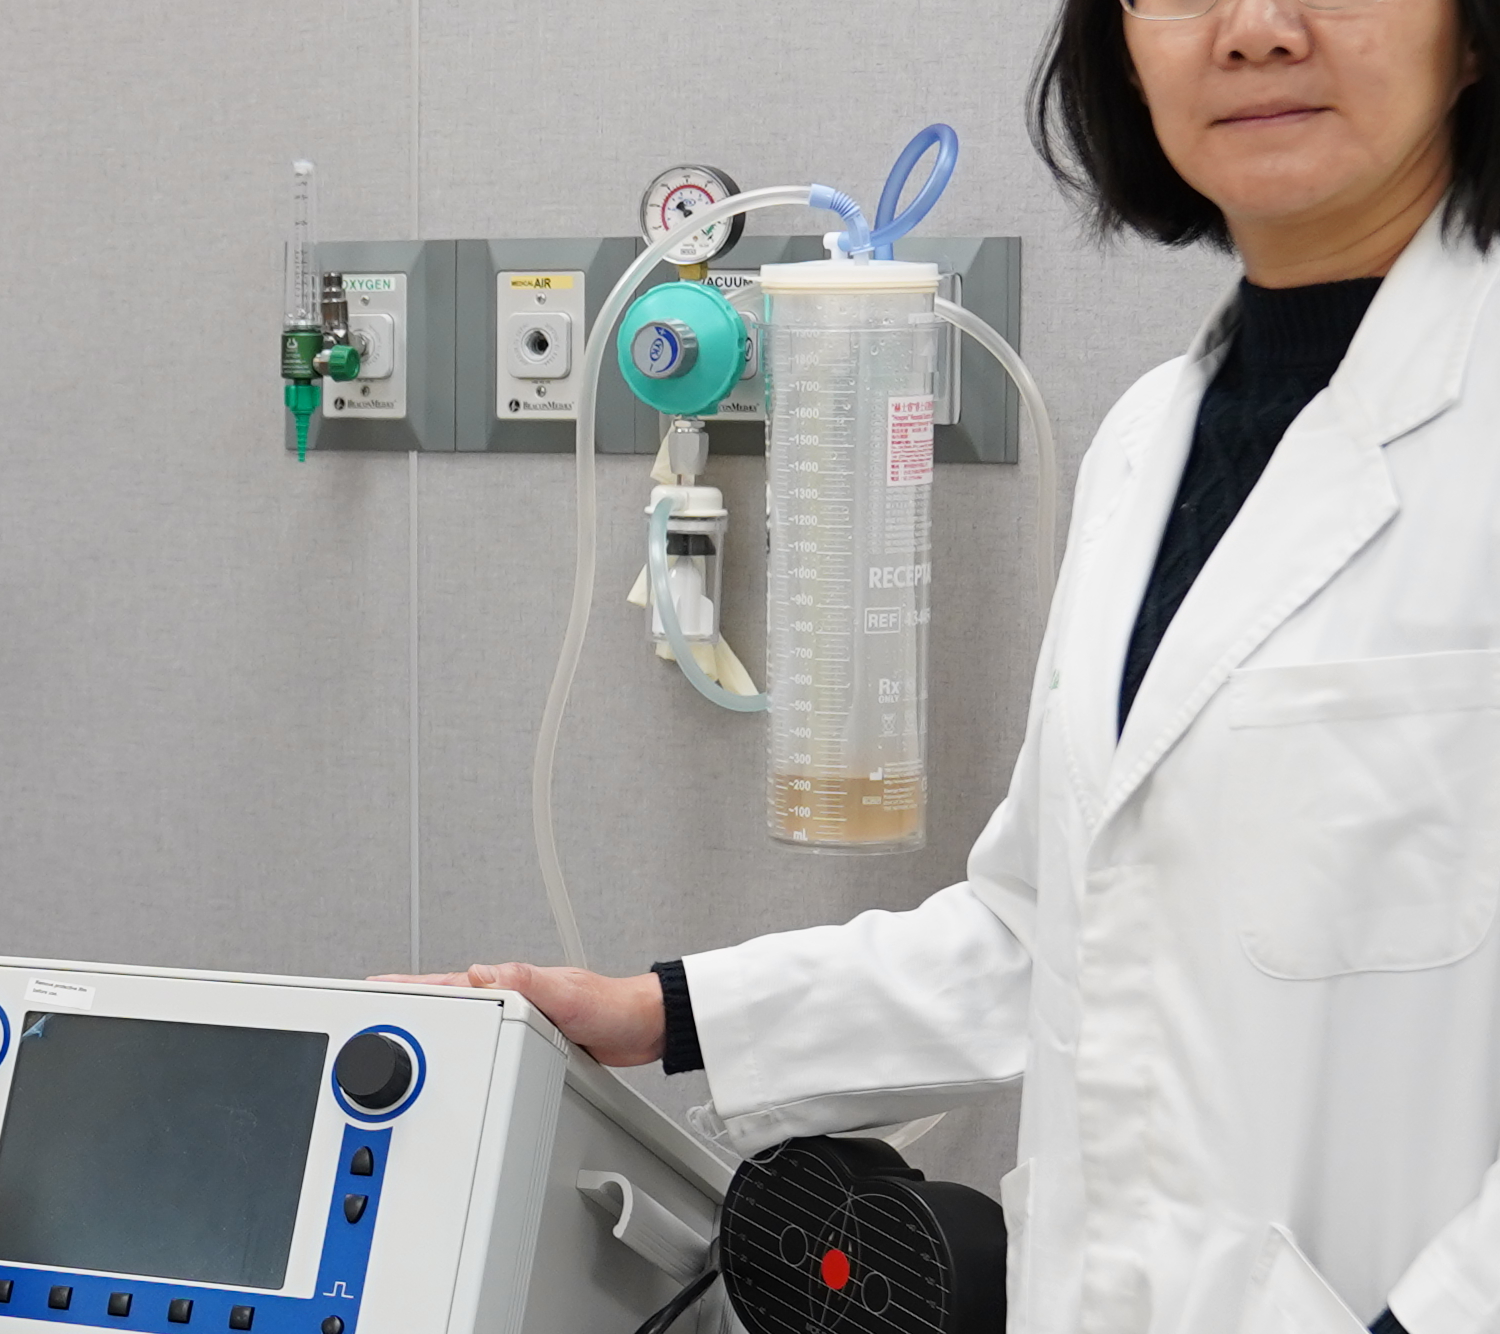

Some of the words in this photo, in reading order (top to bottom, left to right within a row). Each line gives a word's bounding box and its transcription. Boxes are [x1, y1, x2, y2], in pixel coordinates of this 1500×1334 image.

[534, 278, 551, 289] AIR
[868, 613, 898, 628] REF
[879, 679, 900, 695] Rx
